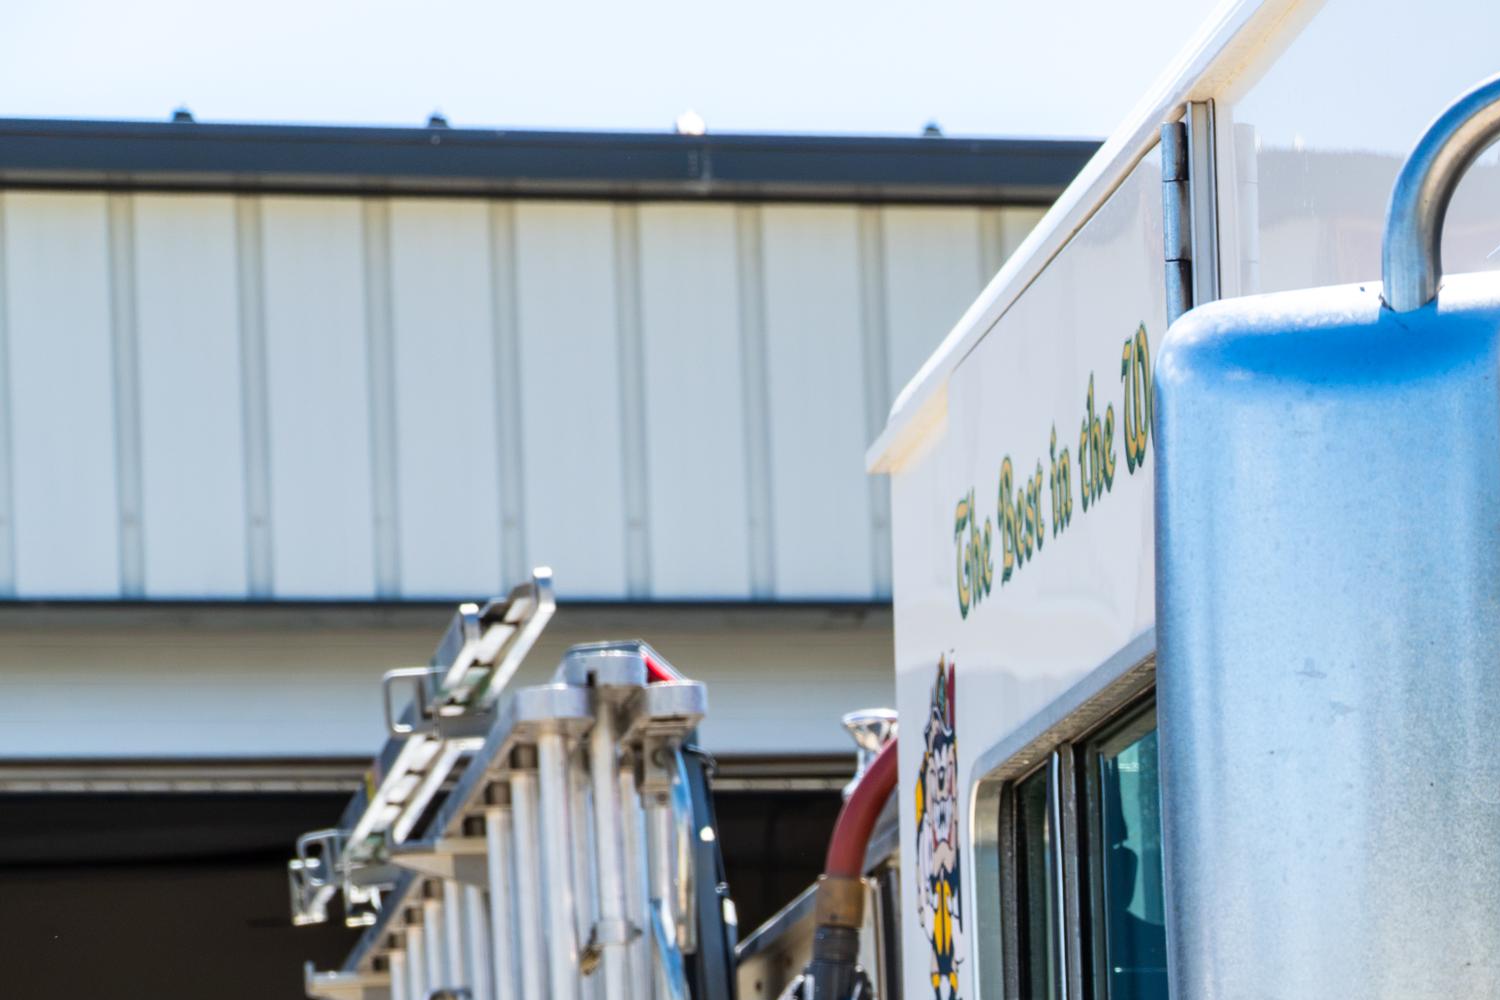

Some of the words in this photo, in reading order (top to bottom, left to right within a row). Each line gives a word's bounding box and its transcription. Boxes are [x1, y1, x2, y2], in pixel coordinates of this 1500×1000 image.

[955, 486, 993, 620] The
[998, 454, 1044, 587] Best
[1050, 421, 1072, 539] in
[1079, 370, 1116, 513] the
[1121, 320, 1155, 475] W
